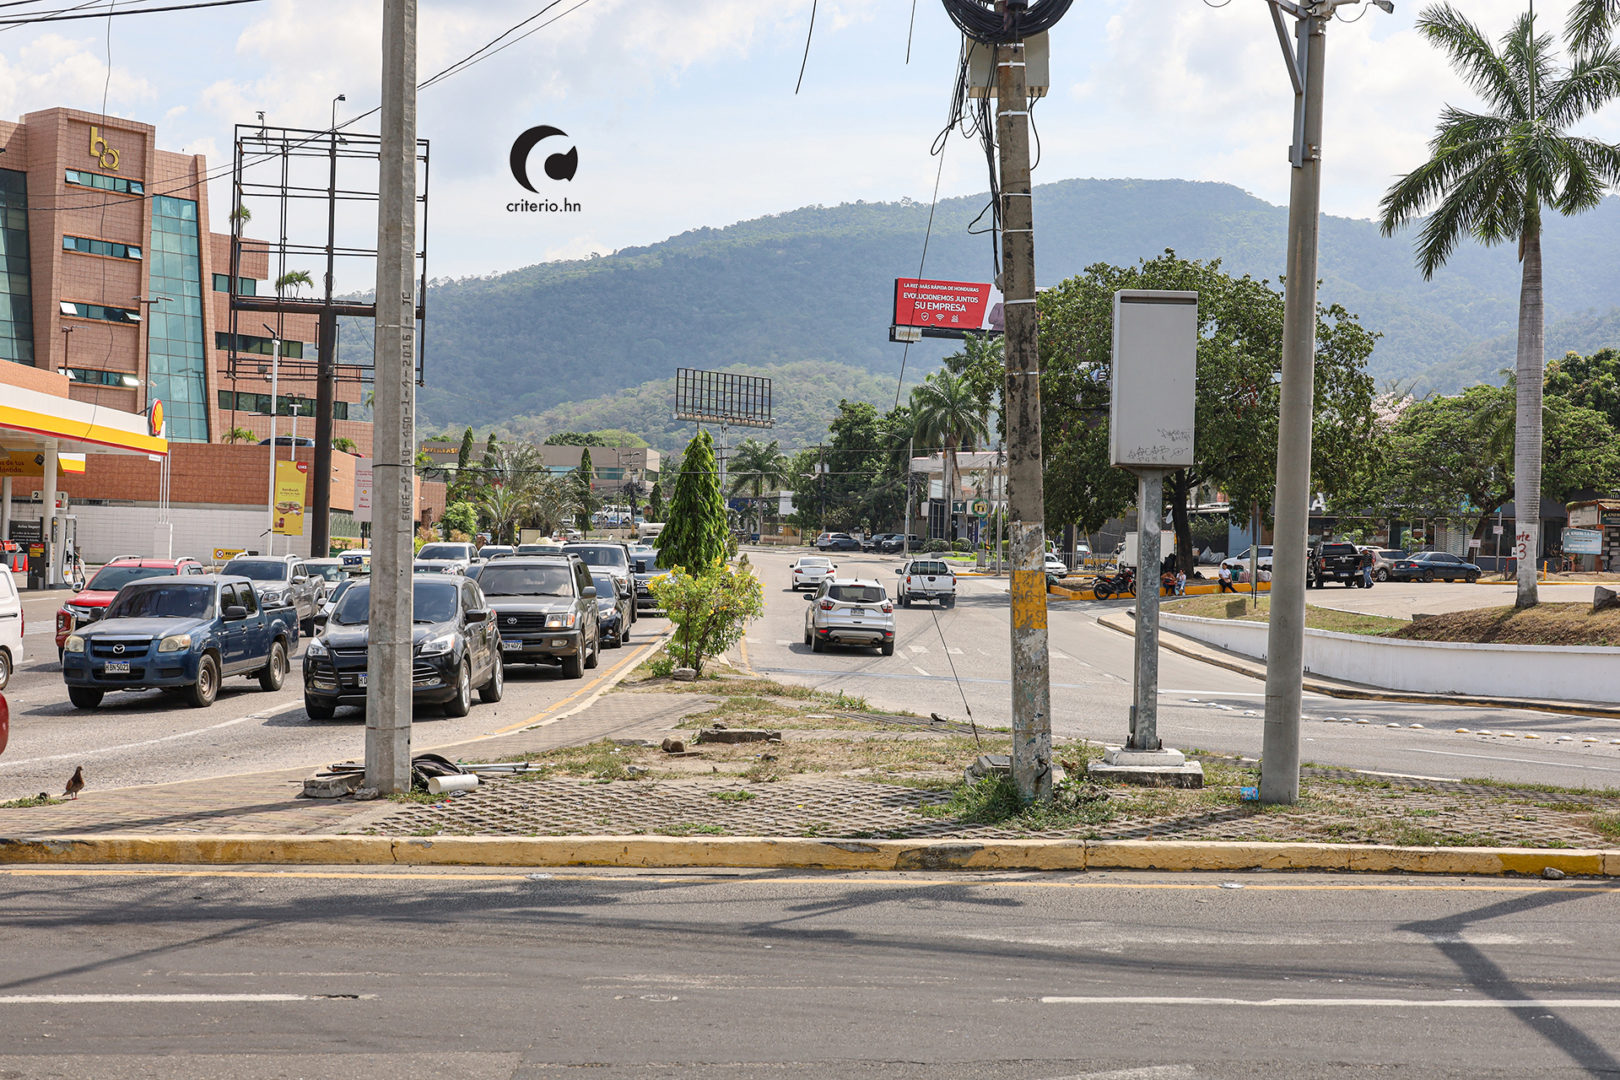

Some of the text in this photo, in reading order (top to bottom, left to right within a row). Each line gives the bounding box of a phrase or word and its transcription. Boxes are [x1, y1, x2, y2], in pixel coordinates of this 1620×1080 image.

[903, 292, 979, 303] EVOLUCIONEMOS JUNTOS
[914, 301, 967, 312] SU EMPRESA
[1518, 542, 1527, 560] 3
